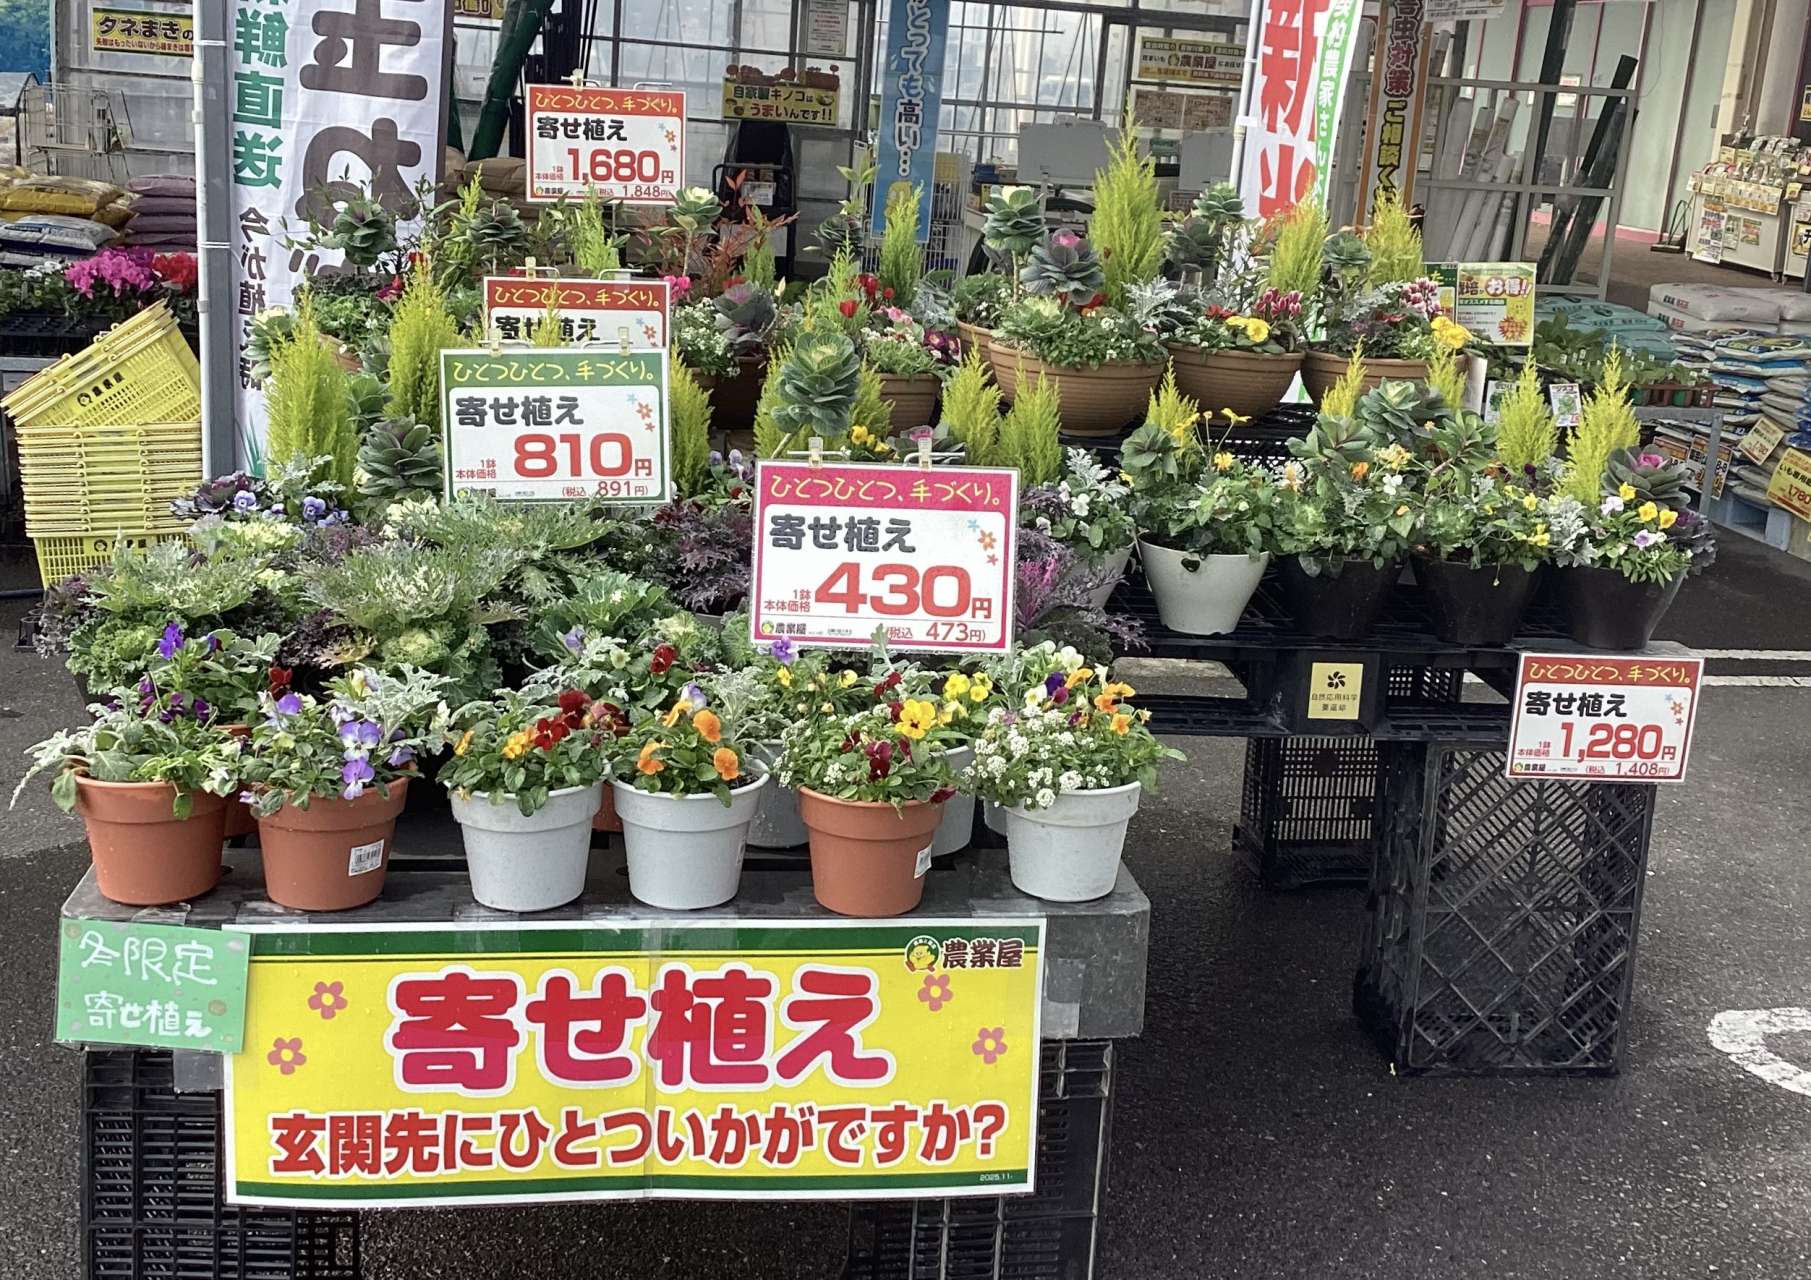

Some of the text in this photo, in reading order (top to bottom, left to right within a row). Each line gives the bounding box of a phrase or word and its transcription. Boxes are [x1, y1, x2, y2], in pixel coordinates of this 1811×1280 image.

[535, 92, 678, 113] ひとつひとつ、手づくり。
[537, 116, 628, 142] 寄せ植え
[494, 286, 661, 308] ひとつひとつ、手づくり。
[452, 359, 654, 382] ひとつひとつ、手づくり。
[455, 395, 585, 428] 寄せ植え
[455, 468, 497, 480] 本体価格
[770, 475, 1001, 506] ひとつひとつ、手づくり。
[770, 514, 916, 553] 寄せ植え
[763, 600, 811, 612] 本体価格
[792, 588, 811, 600] 1鉢
[1529, 662, 1692, 684] ひとつひとつ、手づくり。
[1525, 691, 1628, 718] 寄せ植え
[79, 930, 218, 986] 冬限定
[942, 938, 1024, 969] 農業屋
[84, 990, 213, 1038] 寄せ植え
[389, 967, 892, 1092] 寄せ植え
[271, 1105, 1005, 1176] 玄関先にひとついかがですか?
